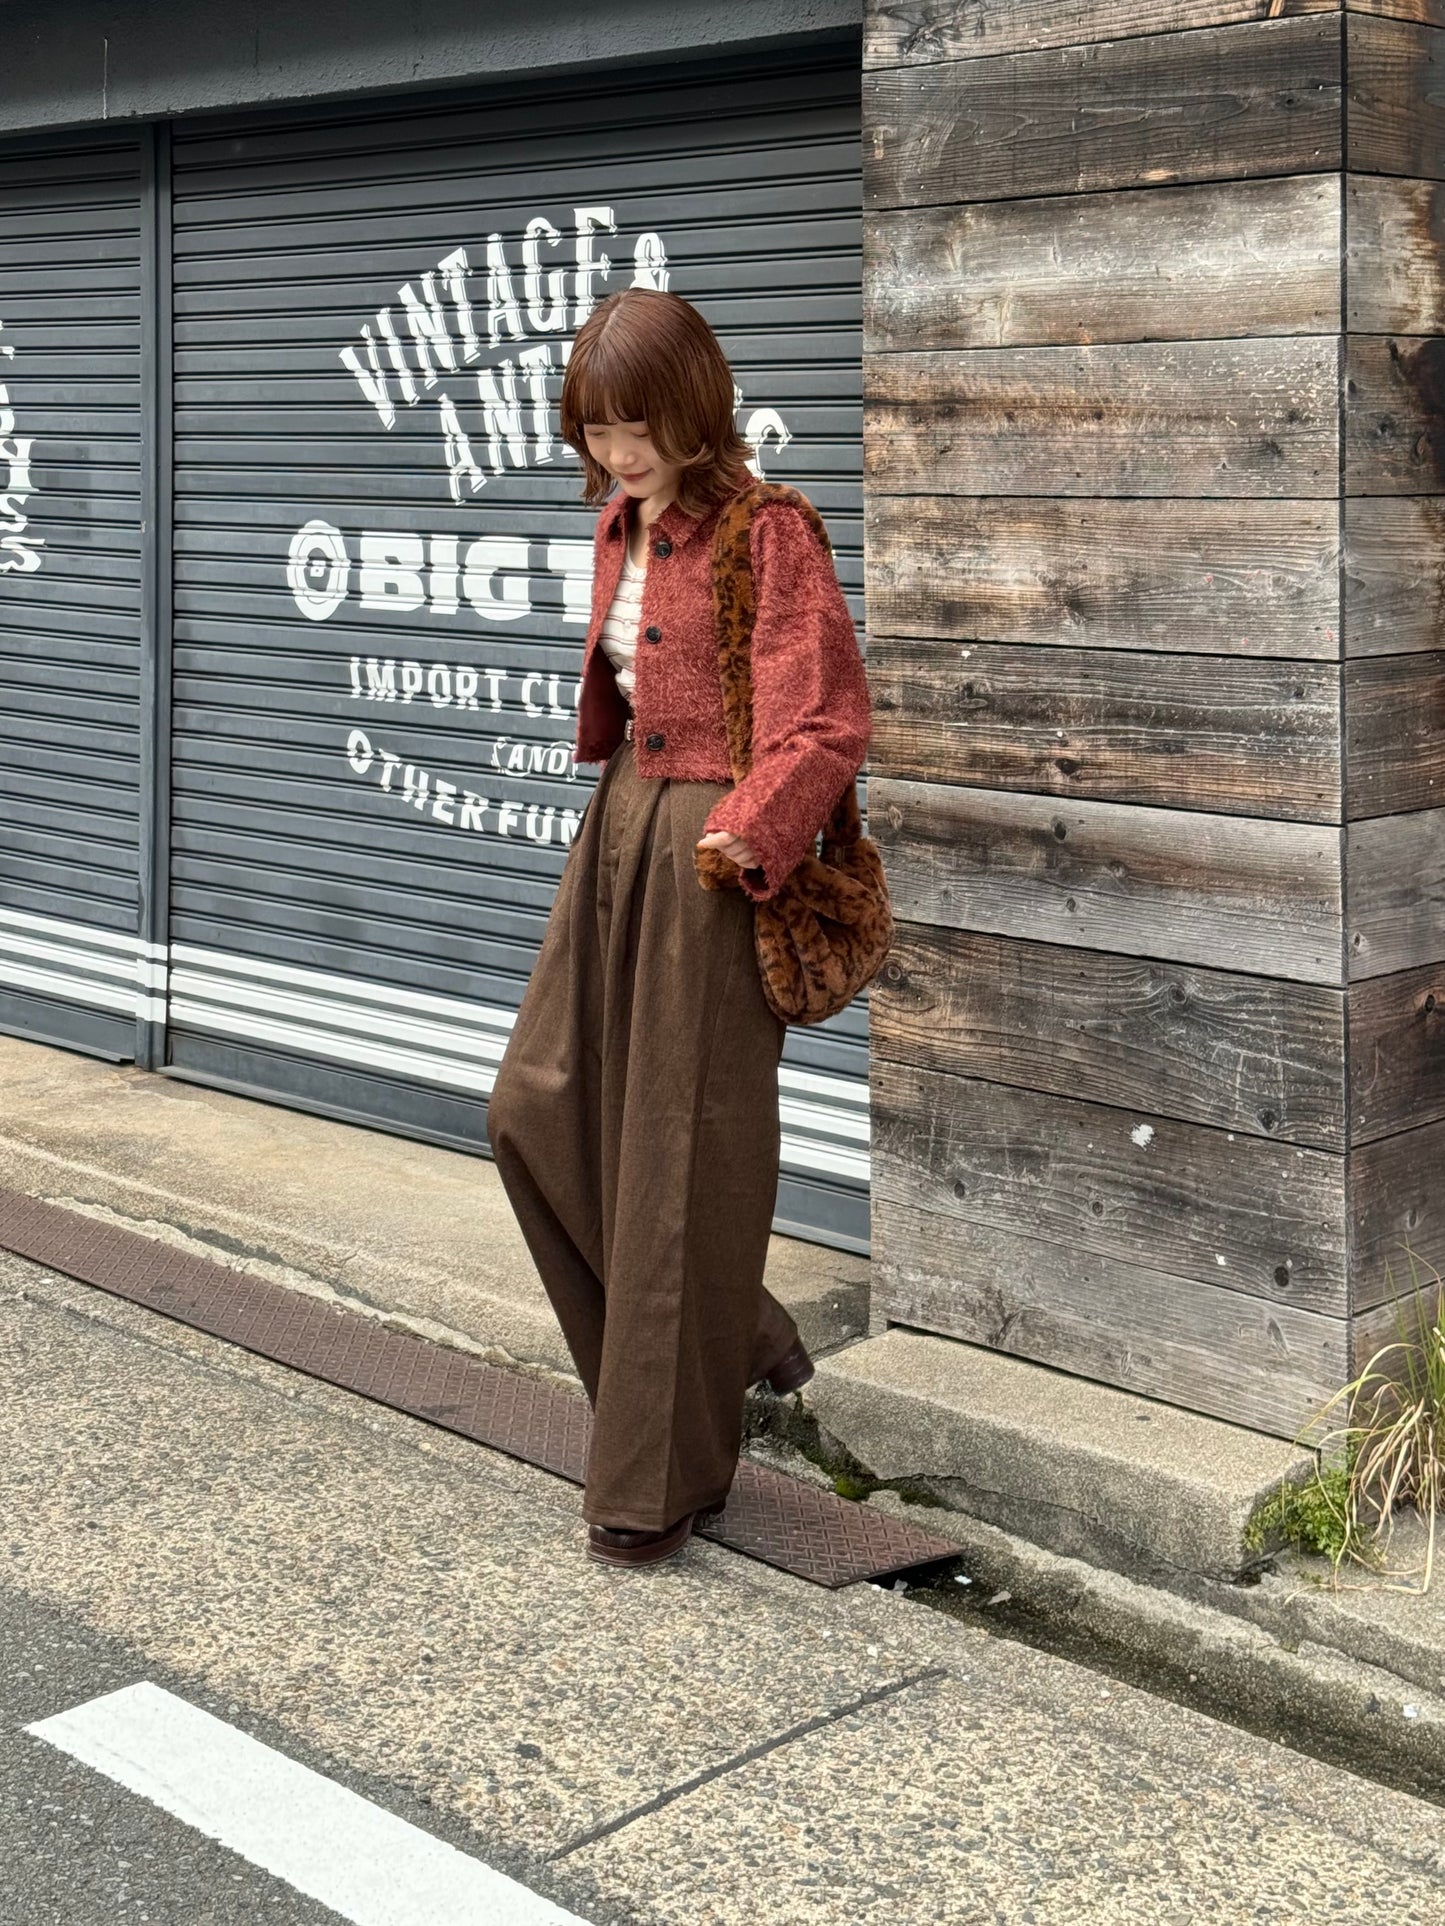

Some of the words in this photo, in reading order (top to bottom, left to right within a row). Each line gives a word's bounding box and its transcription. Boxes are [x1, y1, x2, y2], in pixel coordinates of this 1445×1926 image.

[350, 656, 508, 713] IMPORT
[521, 672, 585, 720] CL
[346, 729, 489, 832] OTHER
[507, 744, 570, 775] AND
